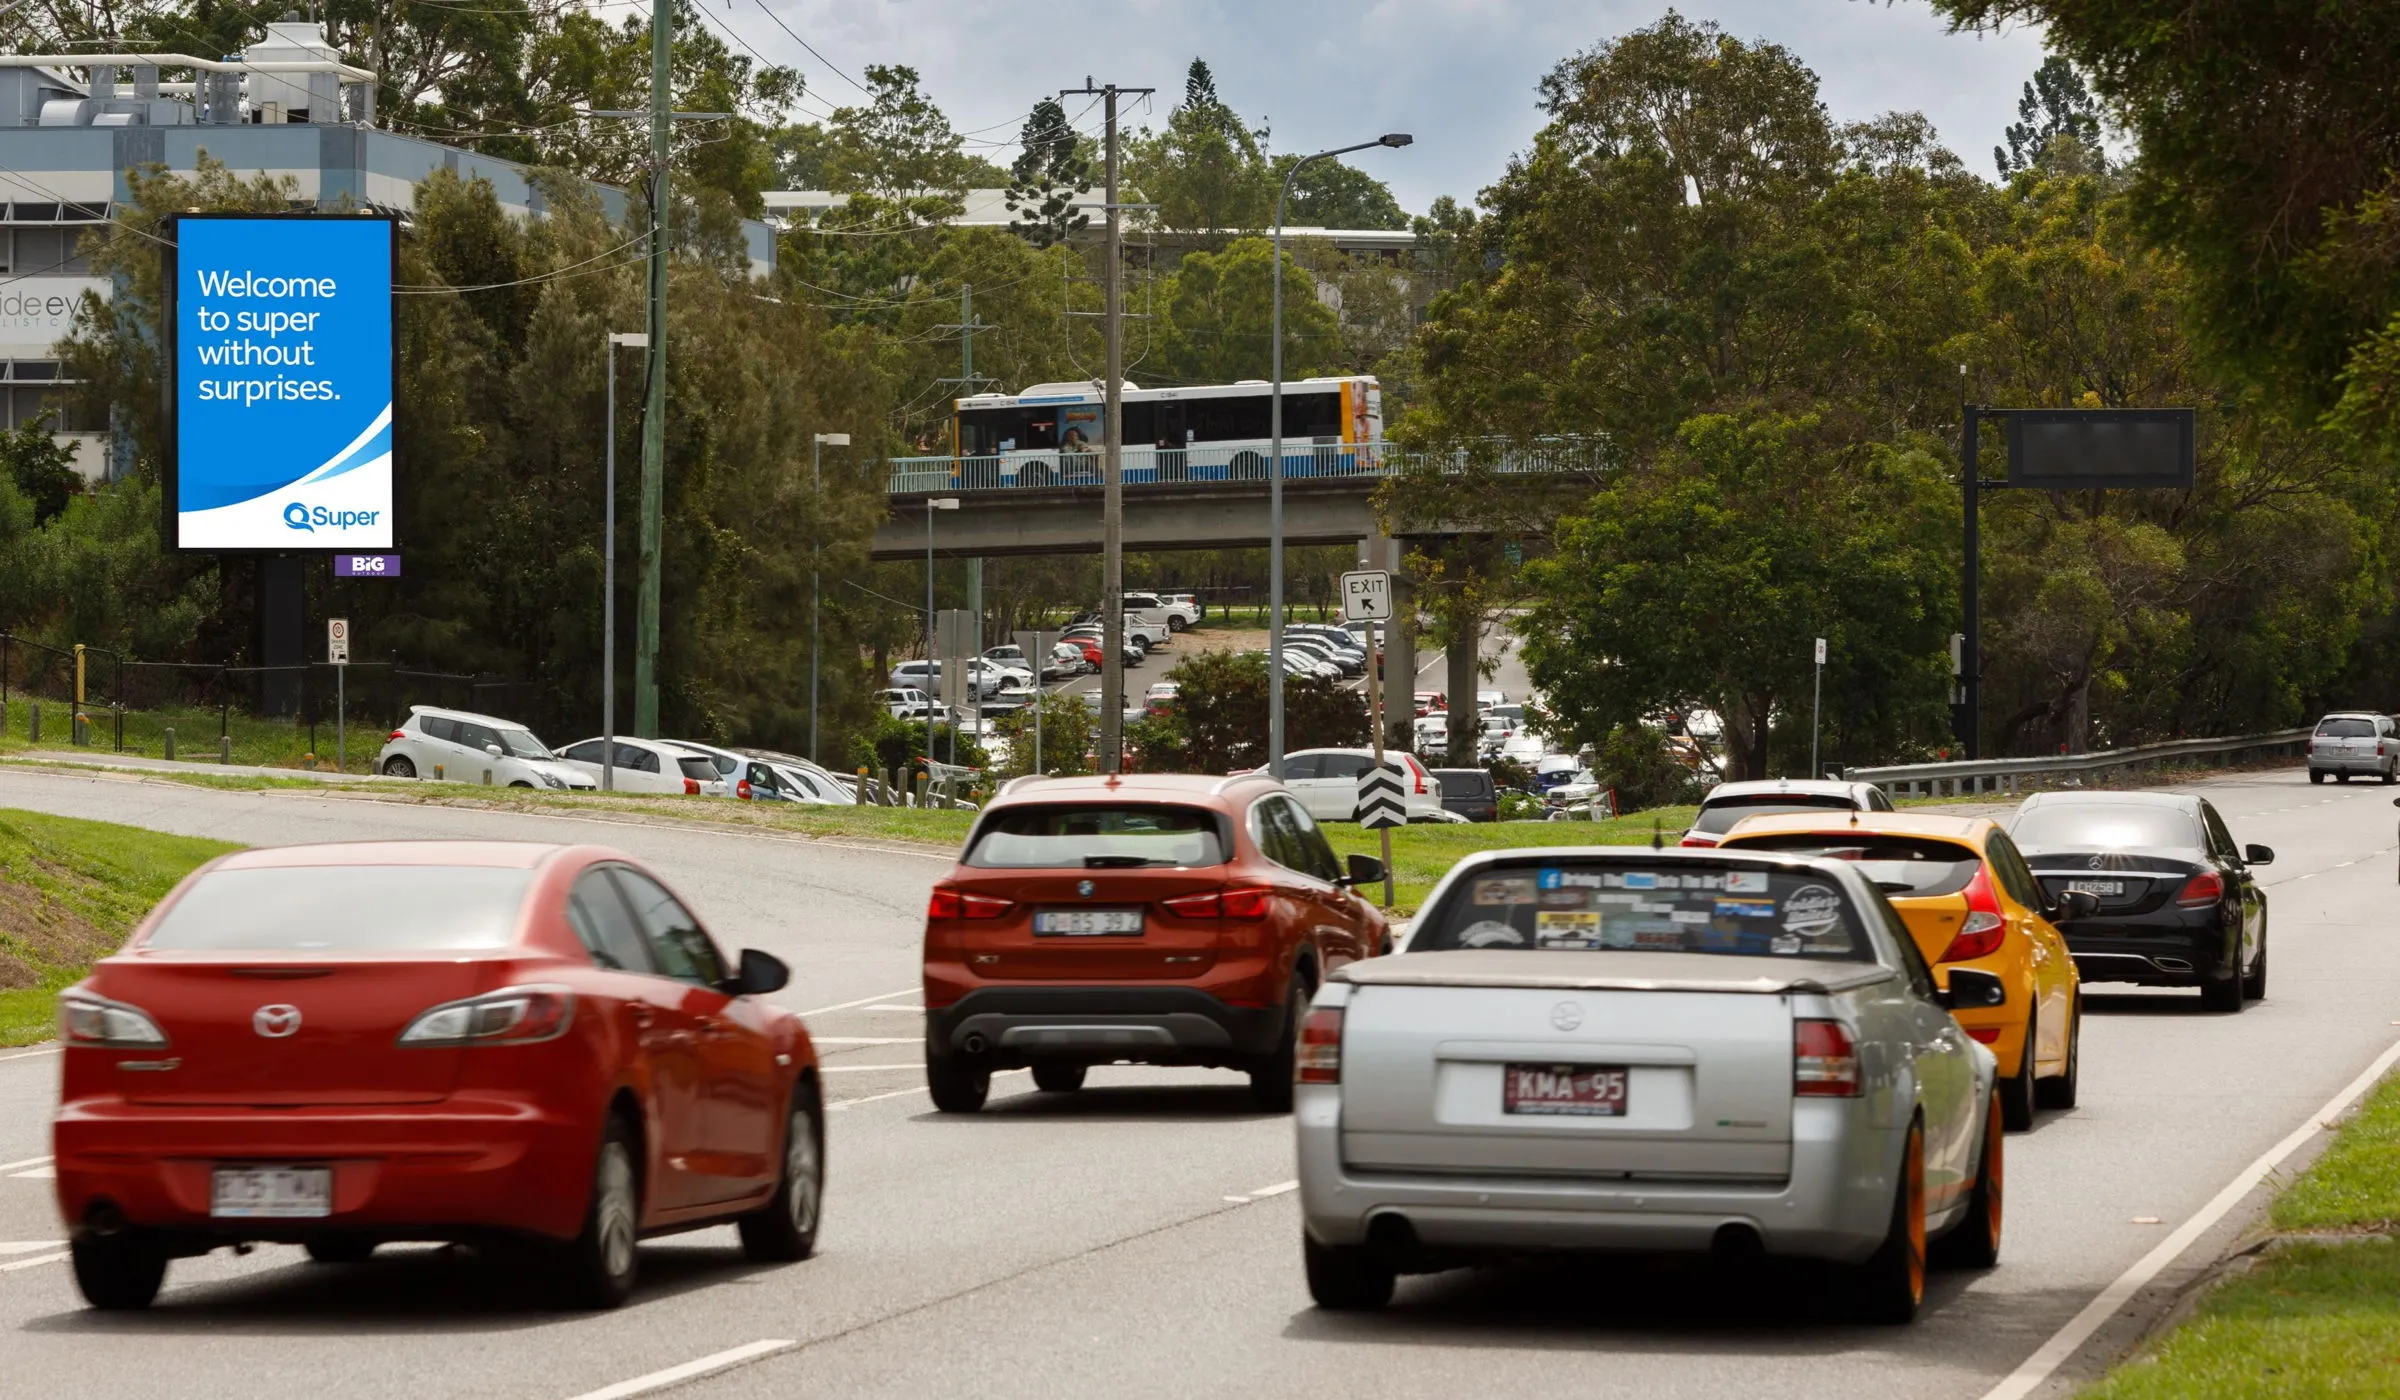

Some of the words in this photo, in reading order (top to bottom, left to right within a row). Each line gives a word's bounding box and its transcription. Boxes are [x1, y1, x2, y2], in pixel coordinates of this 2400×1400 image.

[197, 269, 337, 298] Welcome
[197, 305, 230, 332] to
[236, 311, 321, 339] super
[197, 338, 315, 366] without
[198, 373, 341, 408] surprises.
[1350, 579, 1384, 594] EXIT
[1517, 1071, 1574, 1099] KMA
[1591, 1073, 1626, 1101] 95
